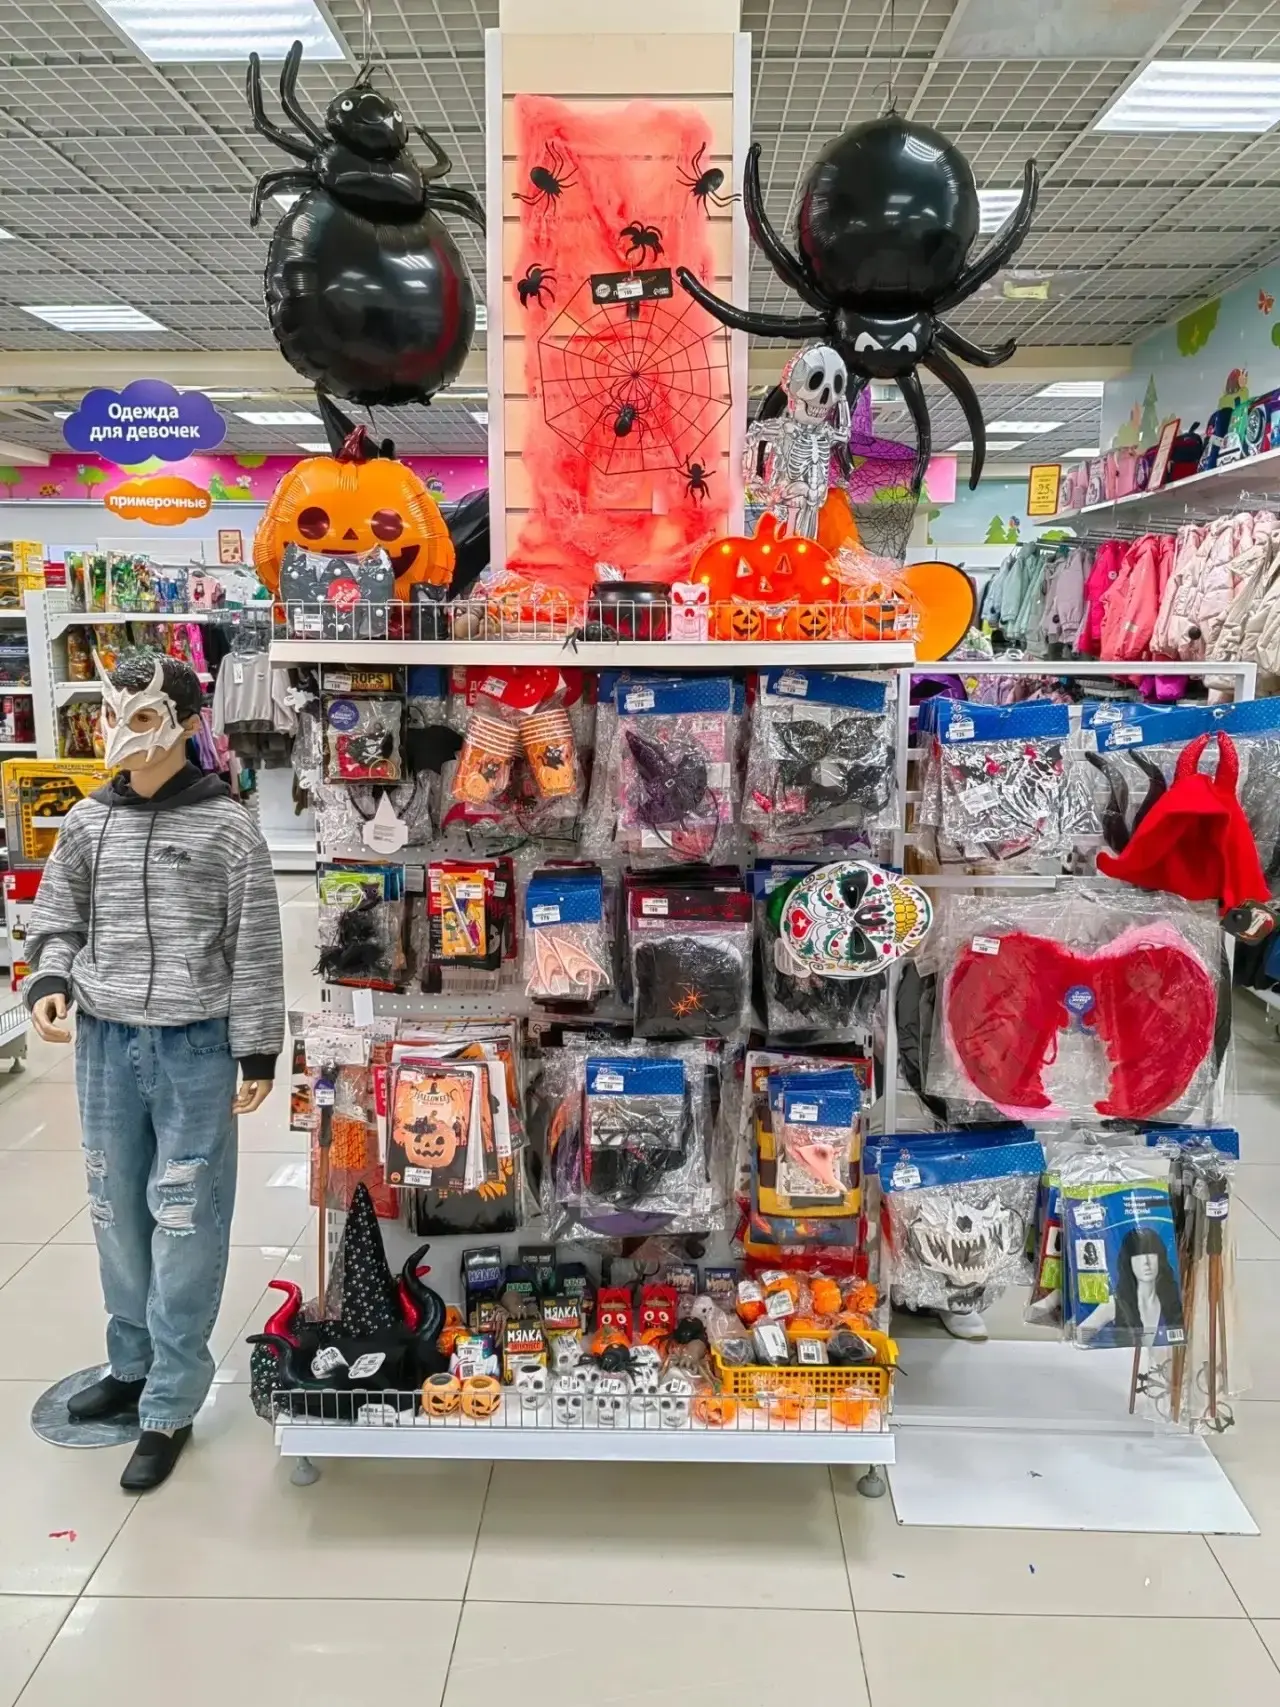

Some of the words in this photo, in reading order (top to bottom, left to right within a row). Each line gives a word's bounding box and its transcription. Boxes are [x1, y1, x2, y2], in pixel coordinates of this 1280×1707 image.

[108, 403, 179, 422] Одежда
[89, 425, 123, 441] для
[126, 425, 200, 441] девочек
[110, 495, 207, 510] примерочные
[544, 1306, 578, 1320] МЯЛКА
[507, 1329, 543, 1342] МЯЛКА
